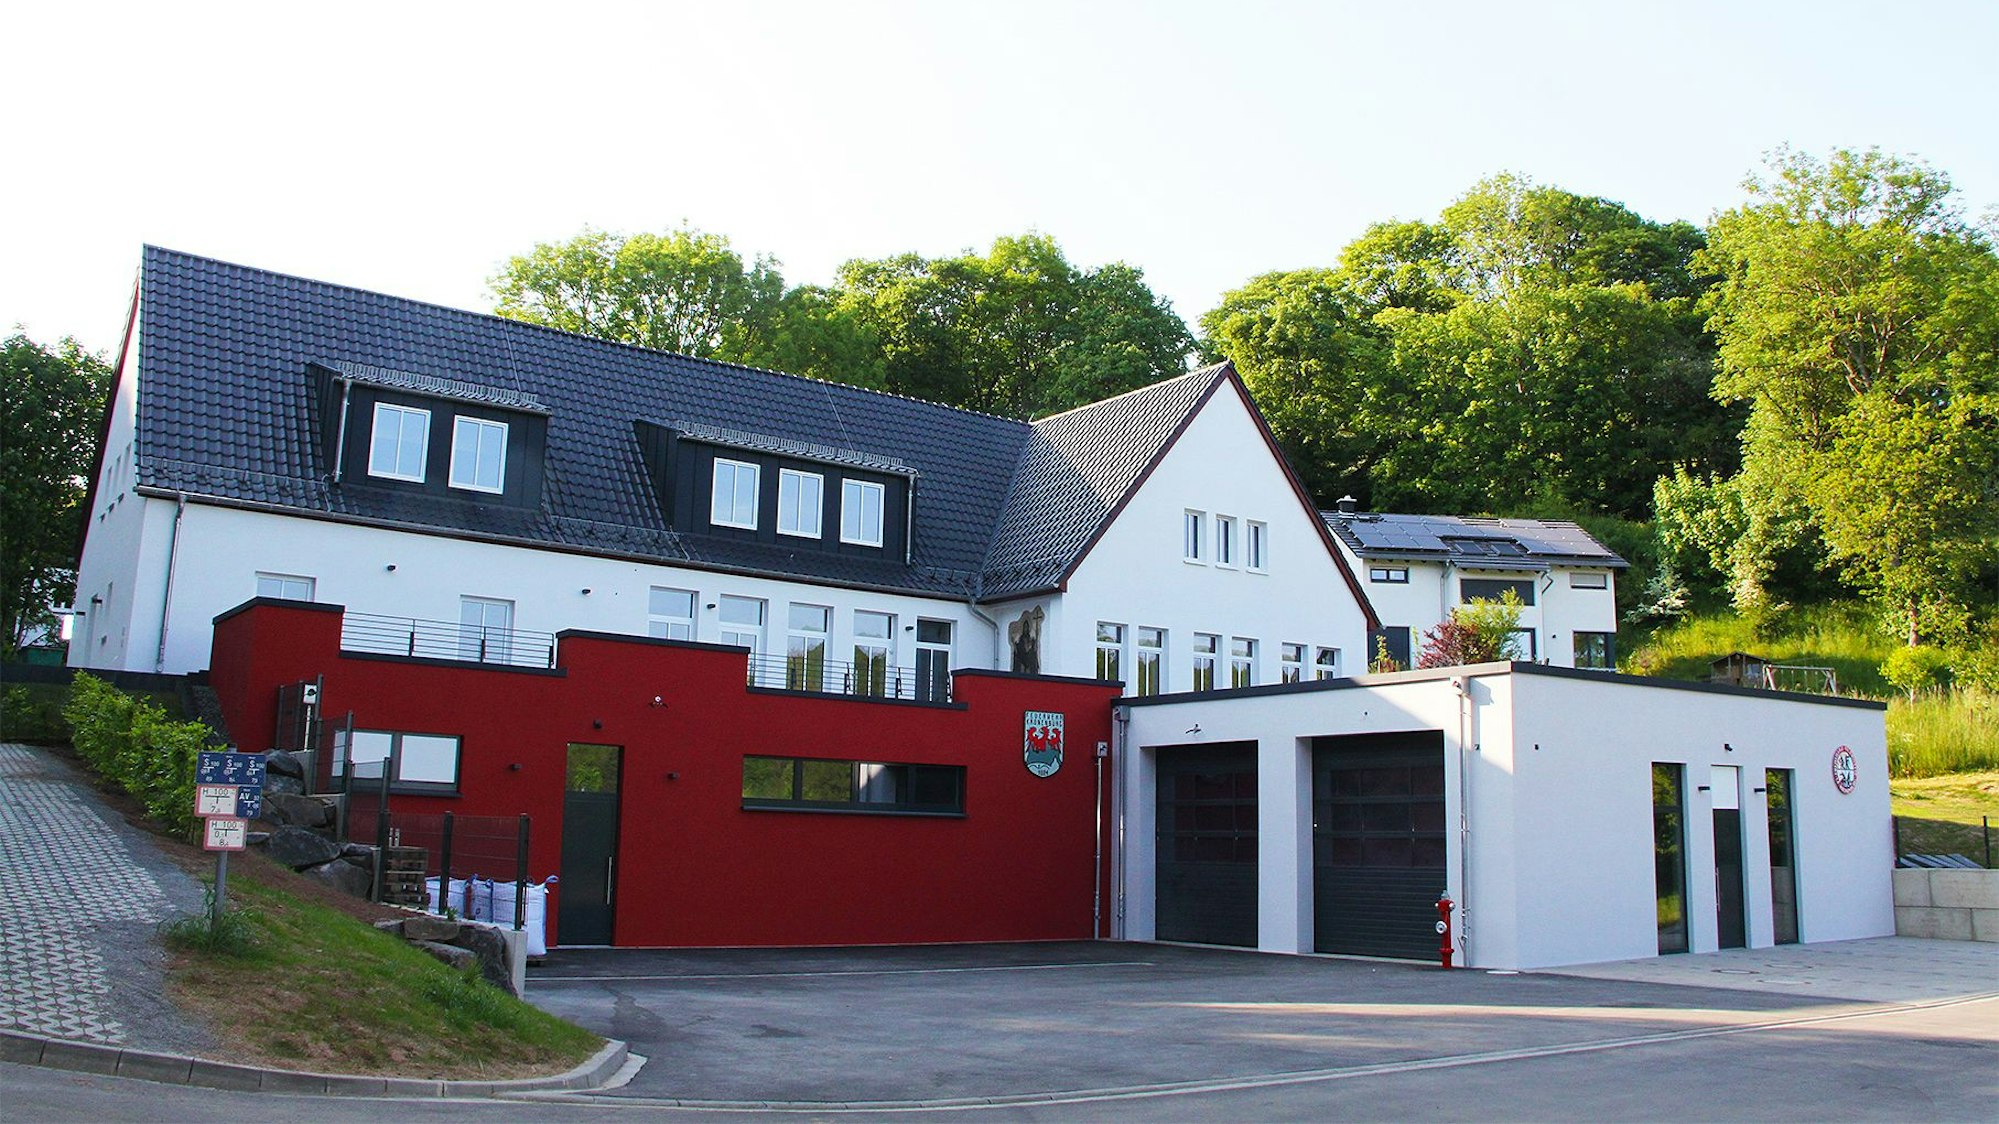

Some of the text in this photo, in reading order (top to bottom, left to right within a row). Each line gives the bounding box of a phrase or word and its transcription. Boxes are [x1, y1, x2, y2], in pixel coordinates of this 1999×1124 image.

[1026, 712, 1063, 720] FEUERWEHR
[1026, 719, 1062, 727] KRONENBURG
[214, 788, 229, 796] 100
[223, 821, 237, 829] 100
